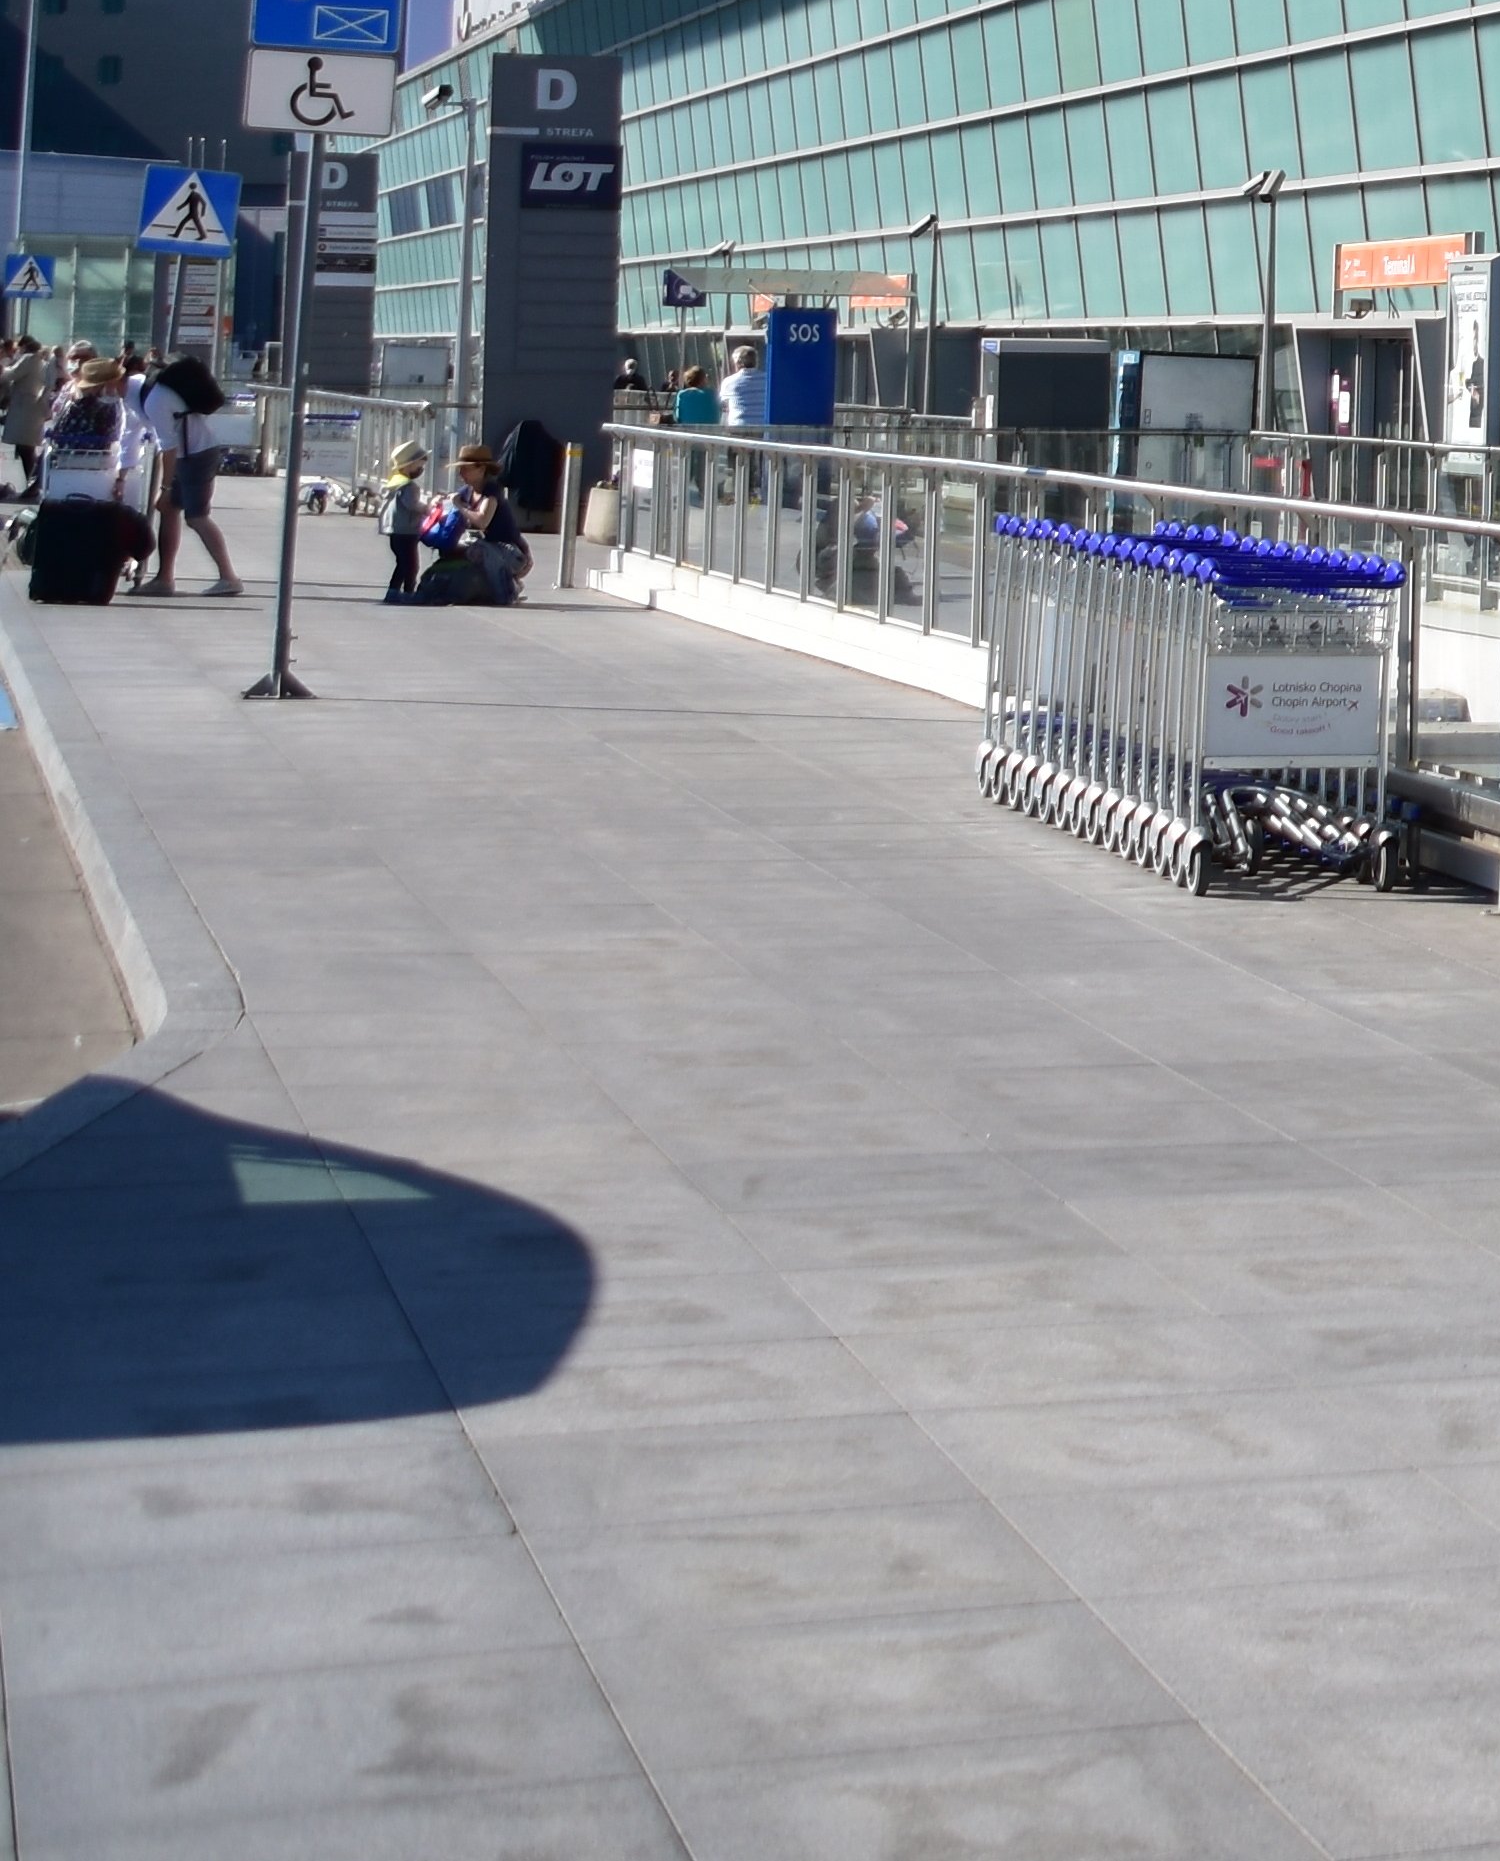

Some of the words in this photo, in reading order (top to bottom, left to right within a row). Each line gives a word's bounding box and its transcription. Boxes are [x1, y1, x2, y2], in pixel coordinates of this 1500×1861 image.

[536, 68, 578, 110] D
[547, 127, 594, 137] STREFA
[321, 161, 349, 190] D
[529, 162, 615, 191] LOT
[789, 323, 820, 342] SOS
[1272, 682, 1316, 693] Lotnisko
[1319, 681, 1362, 694] Chopina
[1271, 696, 1309, 709] Chopin
[1311, 696, 1347, 709] Airport
